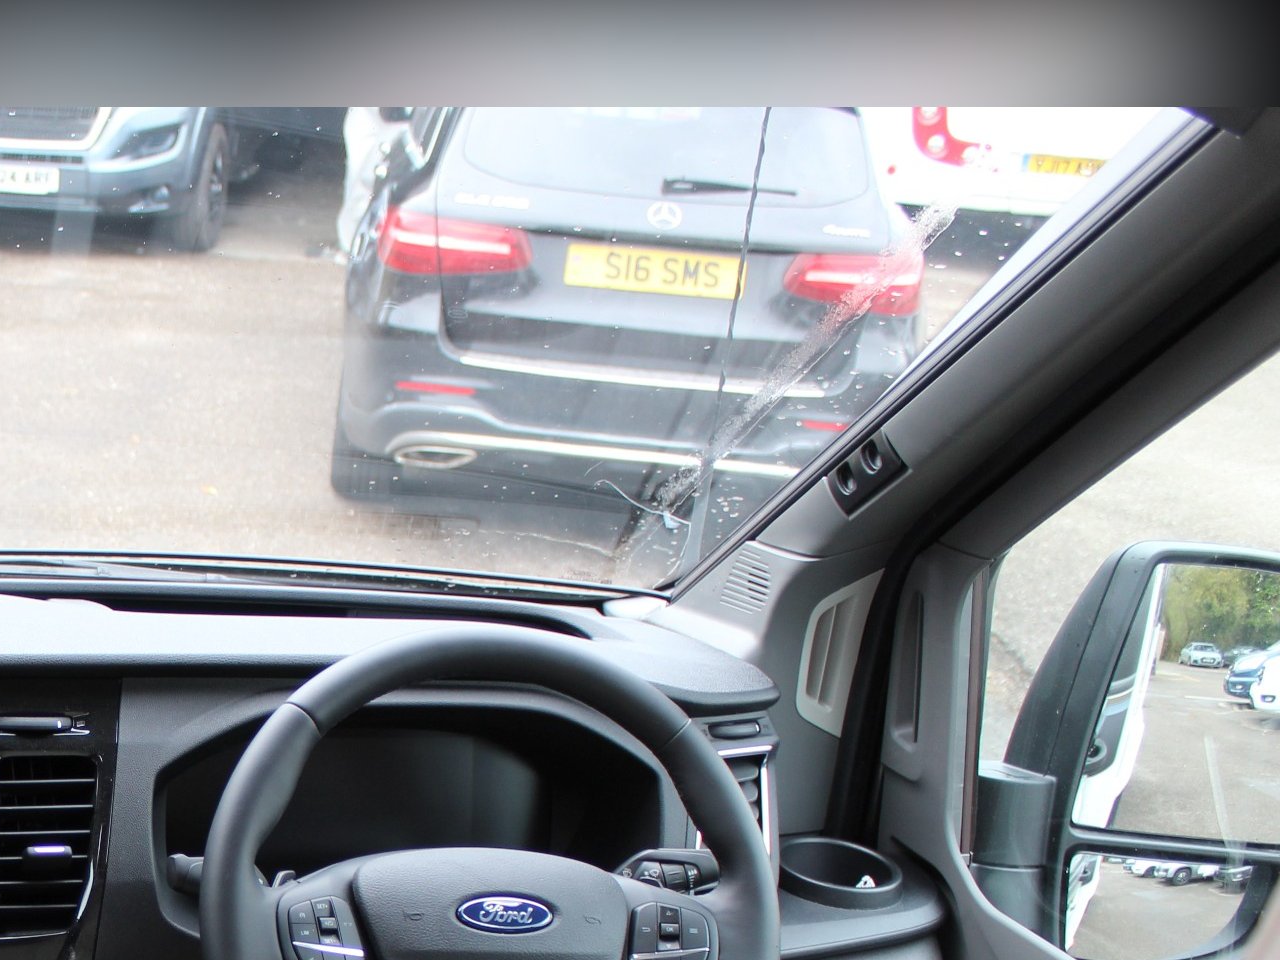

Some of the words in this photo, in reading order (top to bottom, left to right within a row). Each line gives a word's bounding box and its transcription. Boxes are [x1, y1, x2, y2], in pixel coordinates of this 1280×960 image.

[605, 252, 651, 282] S16
[662, 258, 720, 288] SMS
[479, 900, 533, 924] Ford
